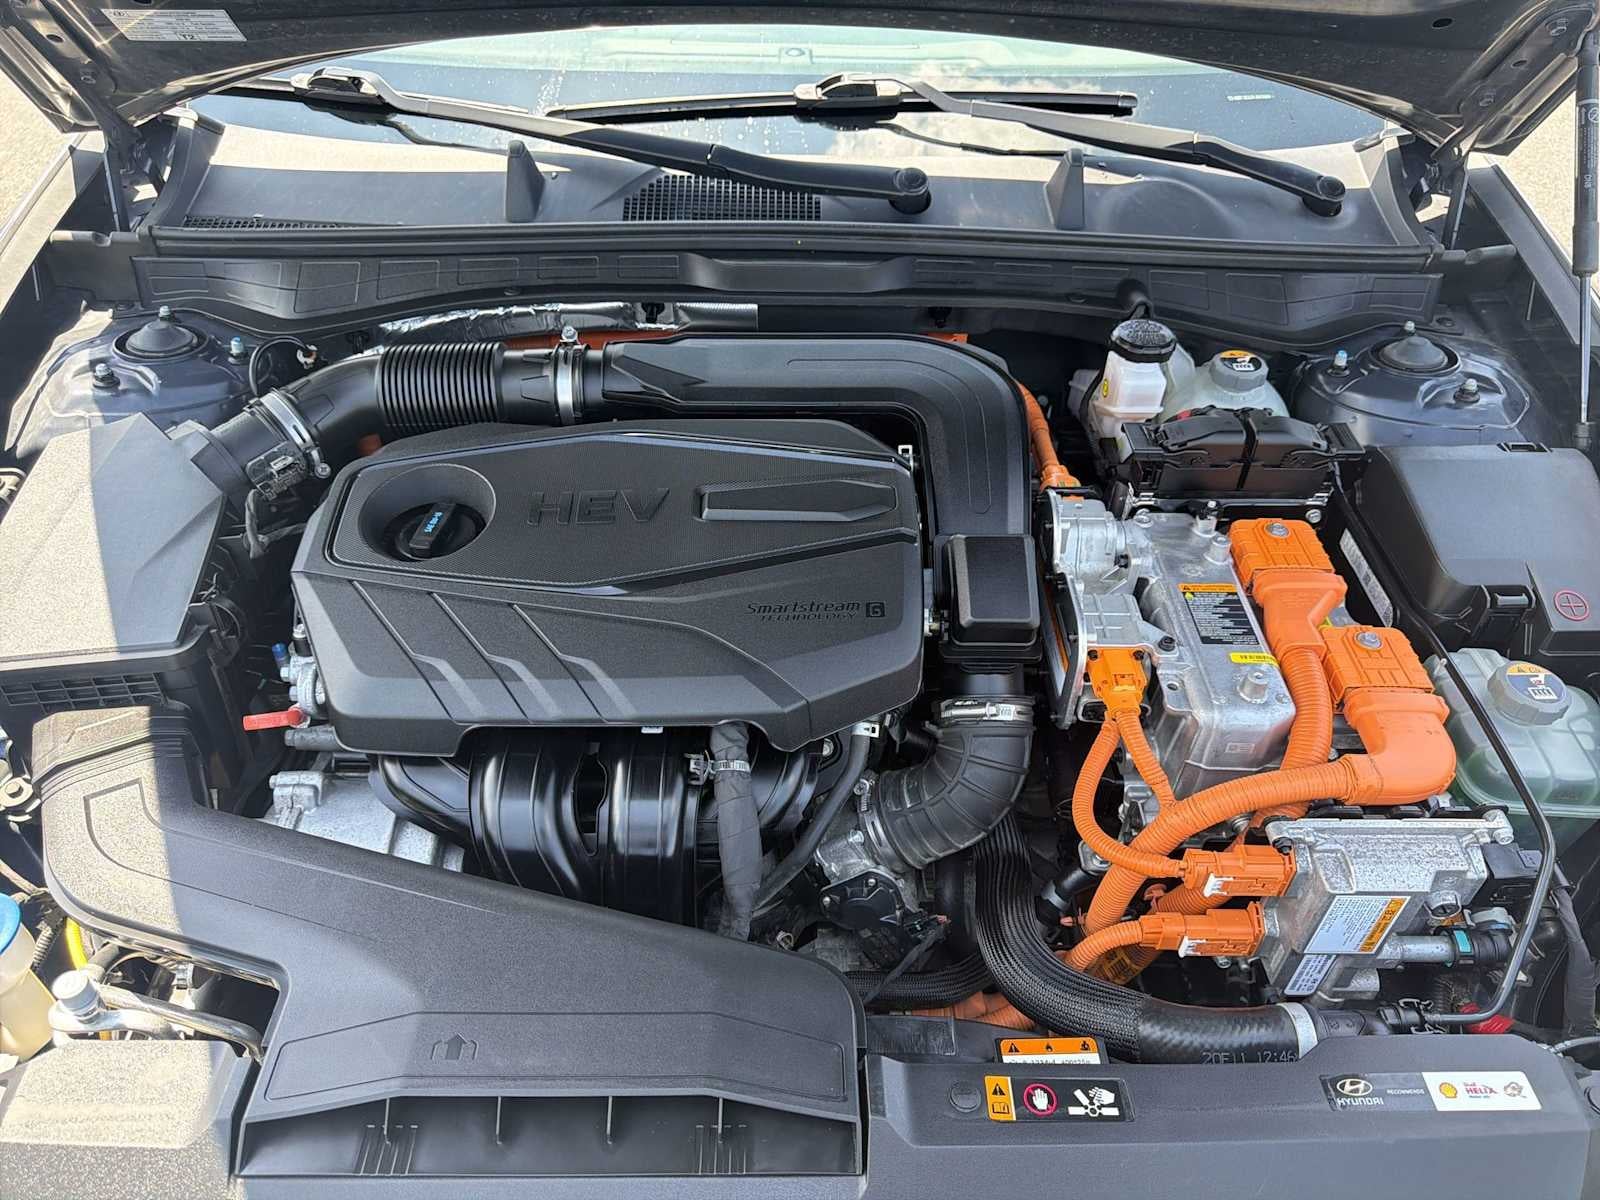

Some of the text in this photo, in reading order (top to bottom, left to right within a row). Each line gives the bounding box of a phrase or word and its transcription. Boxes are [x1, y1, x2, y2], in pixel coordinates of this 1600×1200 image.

[526, 488, 670, 525] HEV
[747, 600, 861, 615] Smartstream
[1336, 1097, 1384, 1106] HYUNDAI
